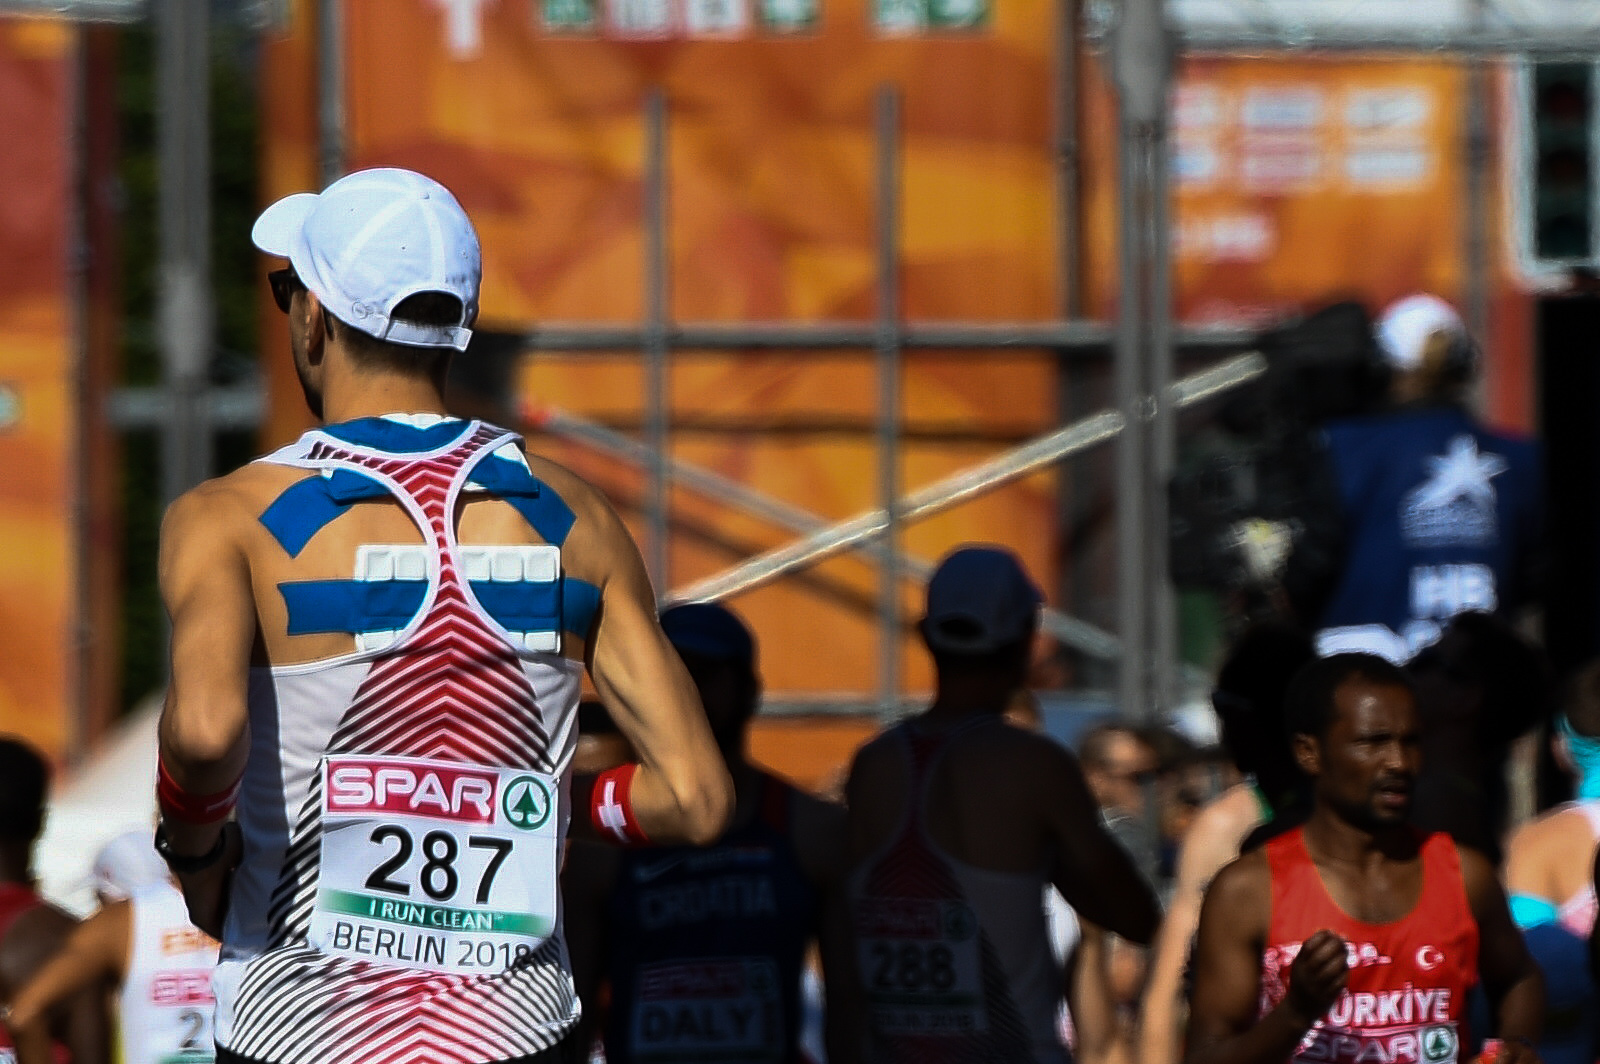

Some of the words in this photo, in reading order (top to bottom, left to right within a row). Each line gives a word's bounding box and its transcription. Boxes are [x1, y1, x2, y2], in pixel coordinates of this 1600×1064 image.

[329, 767, 493, 820] SPAR
[364, 824, 514, 904] 287
[381, 902, 425, 924] RUN
[333, 921, 447, 966] BERLIN
[871, 943, 957, 989] 288
[641, 1004, 754, 1041] DALY
[1328, 981, 1451, 1027] ÜRKİYE
[1305, 1032, 1418, 1064] SPAR
